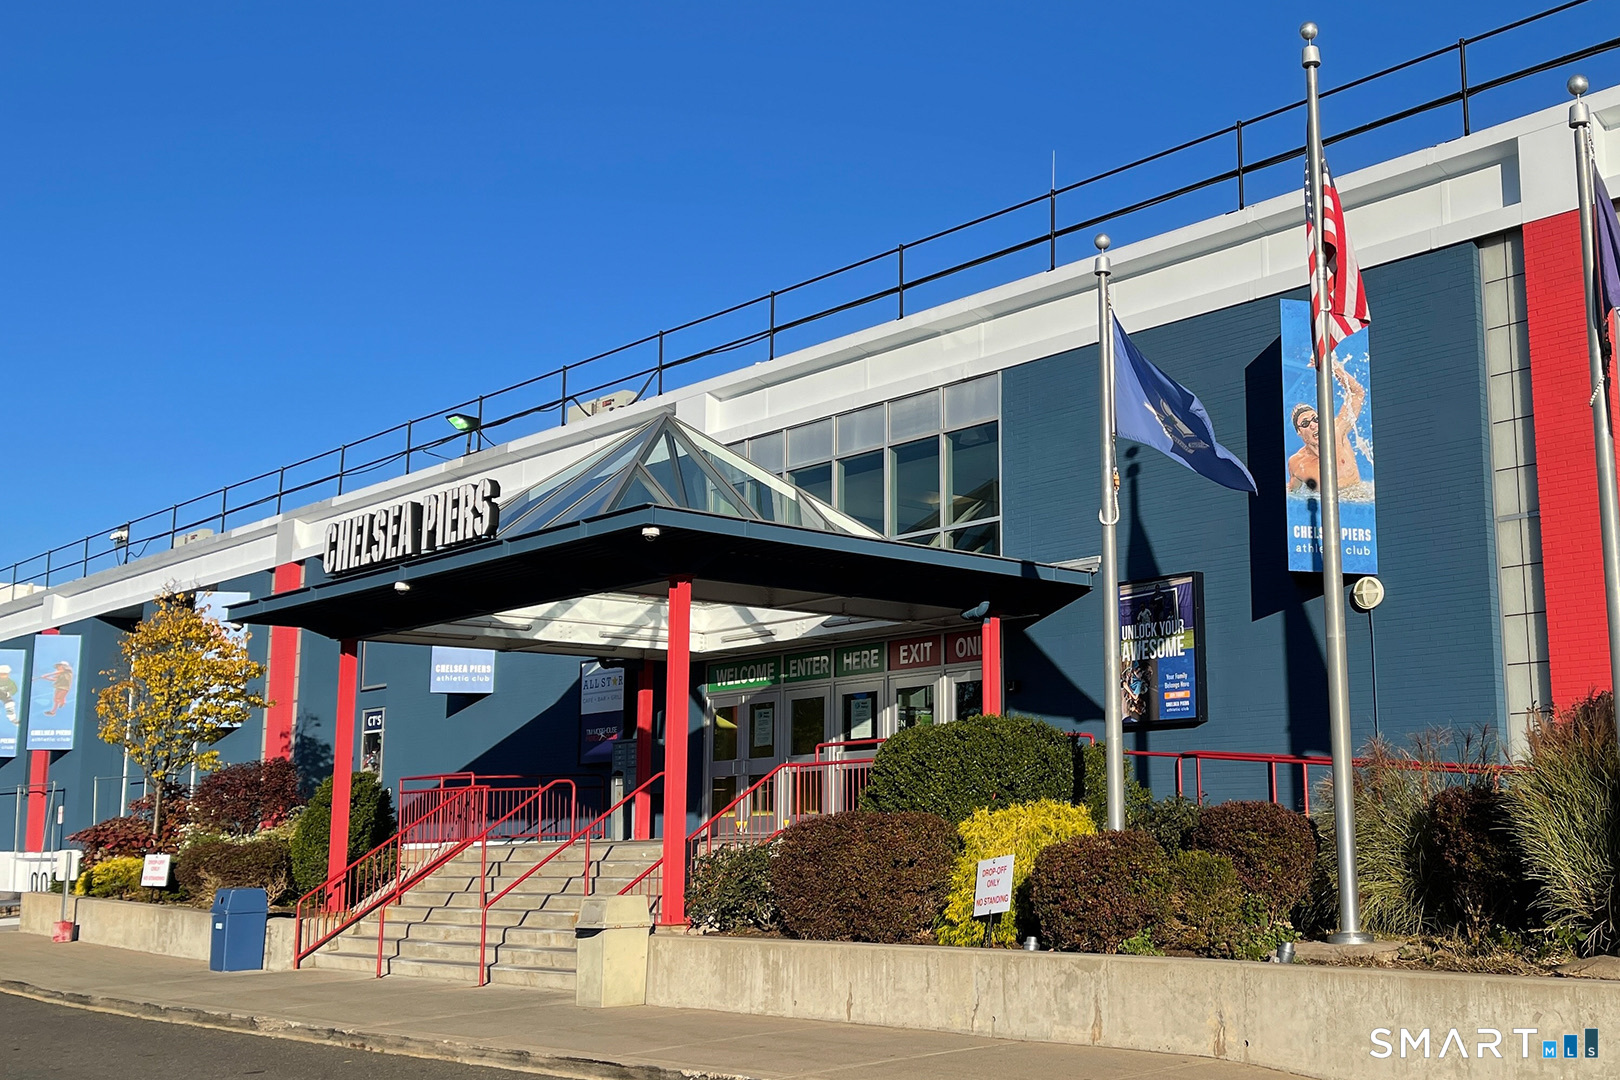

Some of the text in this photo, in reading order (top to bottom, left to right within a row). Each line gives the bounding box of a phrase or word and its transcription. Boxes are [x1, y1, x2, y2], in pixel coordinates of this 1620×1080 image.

[323, 478, 500, 573] CHELSEA PIERS
[1341, 528, 1371, 541] PIERS
[1345, 545, 1371, 556] club
[1121, 618, 1185, 641] UNLOCK YOUR
[900, 635, 982, 664] EXIT ONL
[1122, 635, 1185, 662] AWESOME
[435, 664, 492, 673] CHELSEA PIERS
[716, 648, 880, 686] WELCOME ENTER HERE
[1175, 672, 1188, 680] Family
[982, 865, 1007, 877] DROP-OFF
[987, 879, 1000, 888] ONLY
[976, 894, 1009, 906] NO STANDING
